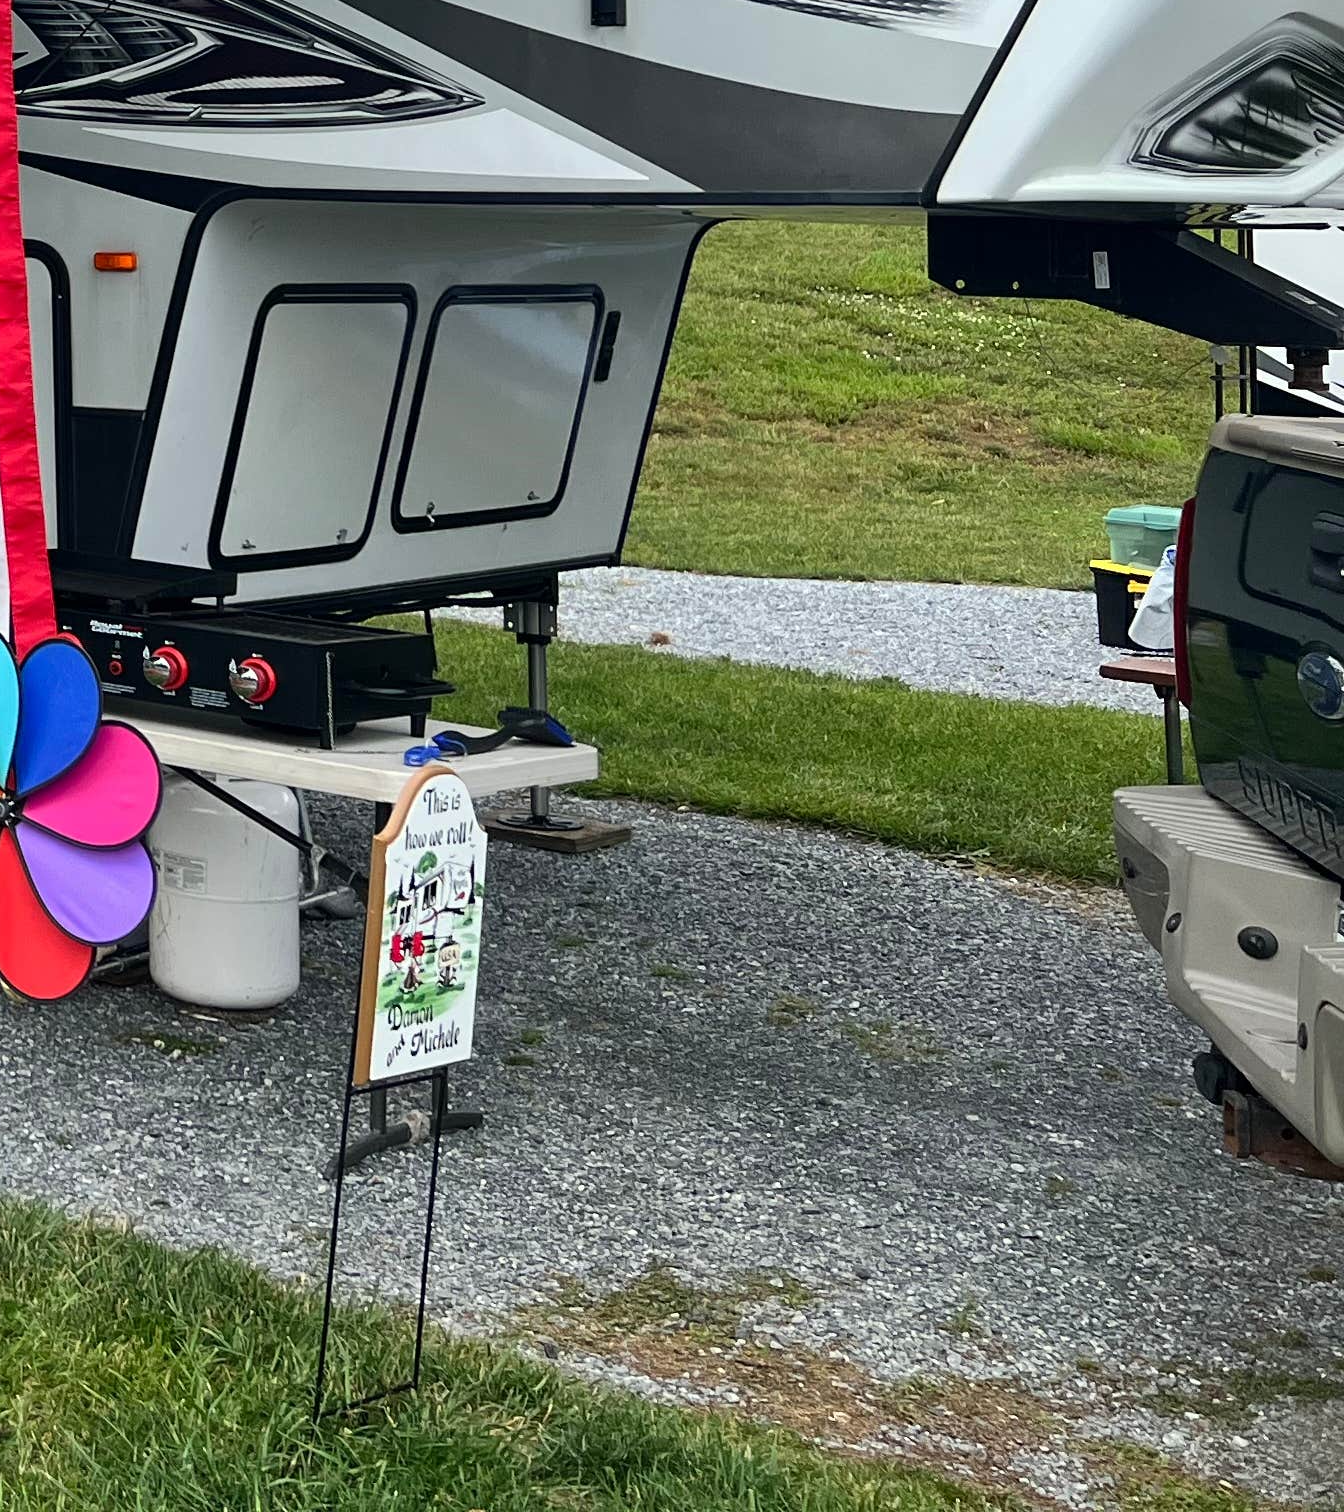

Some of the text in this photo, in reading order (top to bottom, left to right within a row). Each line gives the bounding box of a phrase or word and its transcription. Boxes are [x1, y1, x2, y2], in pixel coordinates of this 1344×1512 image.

[423, 787, 461, 816] This is
[1238, 759, 1343, 859] SUPER
[404, 819, 473, 850] how we roll!
[410, 1019, 461, 1057] Michele
